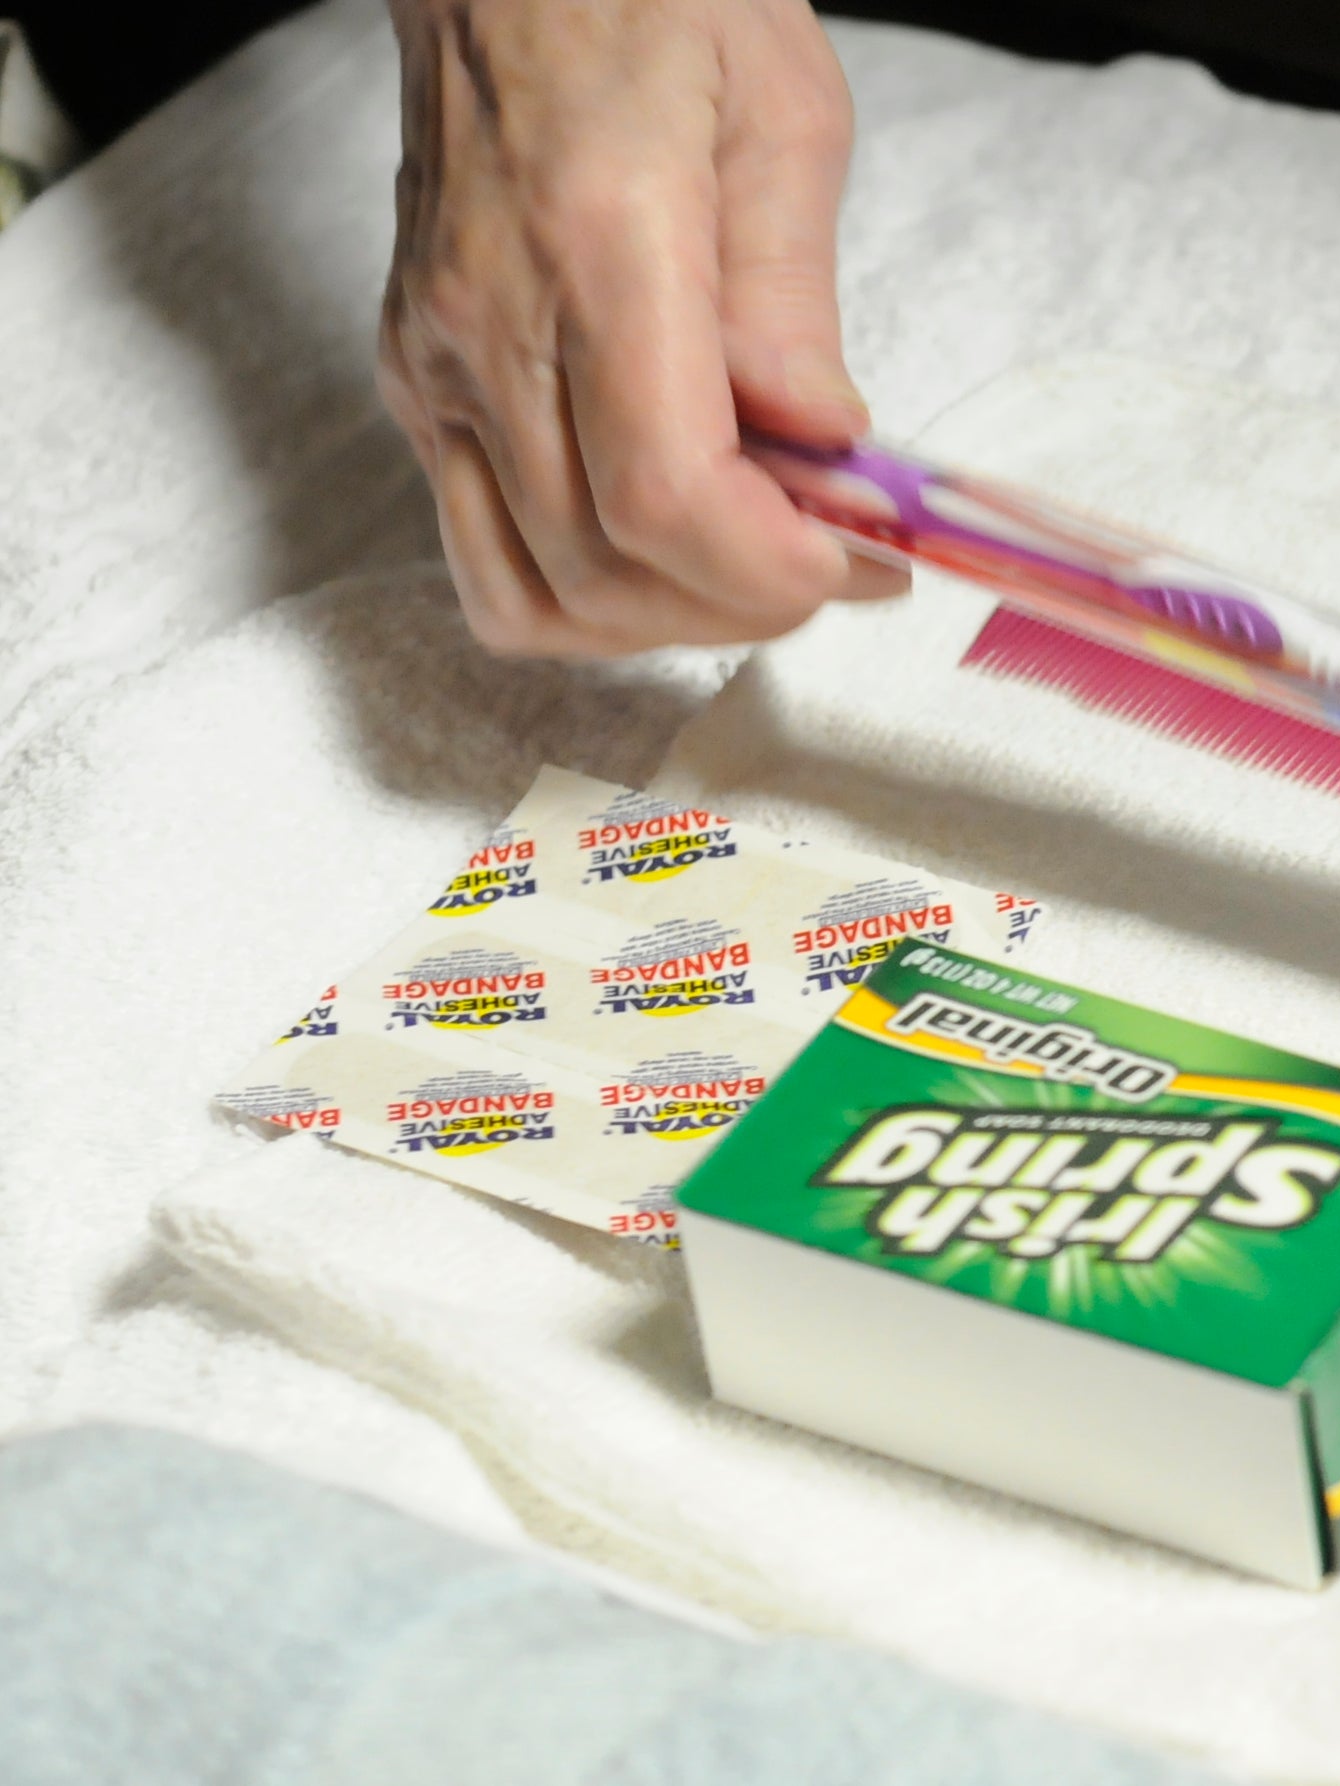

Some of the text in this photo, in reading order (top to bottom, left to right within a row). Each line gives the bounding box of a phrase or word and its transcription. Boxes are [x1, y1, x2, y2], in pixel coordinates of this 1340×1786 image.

[591, 827, 731, 865] ADHESIVE
[793, 904, 953, 954] BANDAGE
[589, 941, 751, 984] BANDAGE
[382, 971, 546, 1000] BANDAGE
[603, 970, 748, 998] ADHESIVE
[394, 992, 541, 1013] ADHESIVE
[890, 997, 1174, 1098] Original
[386, 1091, 555, 1122] BANDAGE
[599, 1076, 766, 1108] BANDAGE
[399, 1111, 550, 1137] ADHESIVE
[608, 1112, 745, 1135] OYAL
[872, 1184, 1200, 1261] Irish
